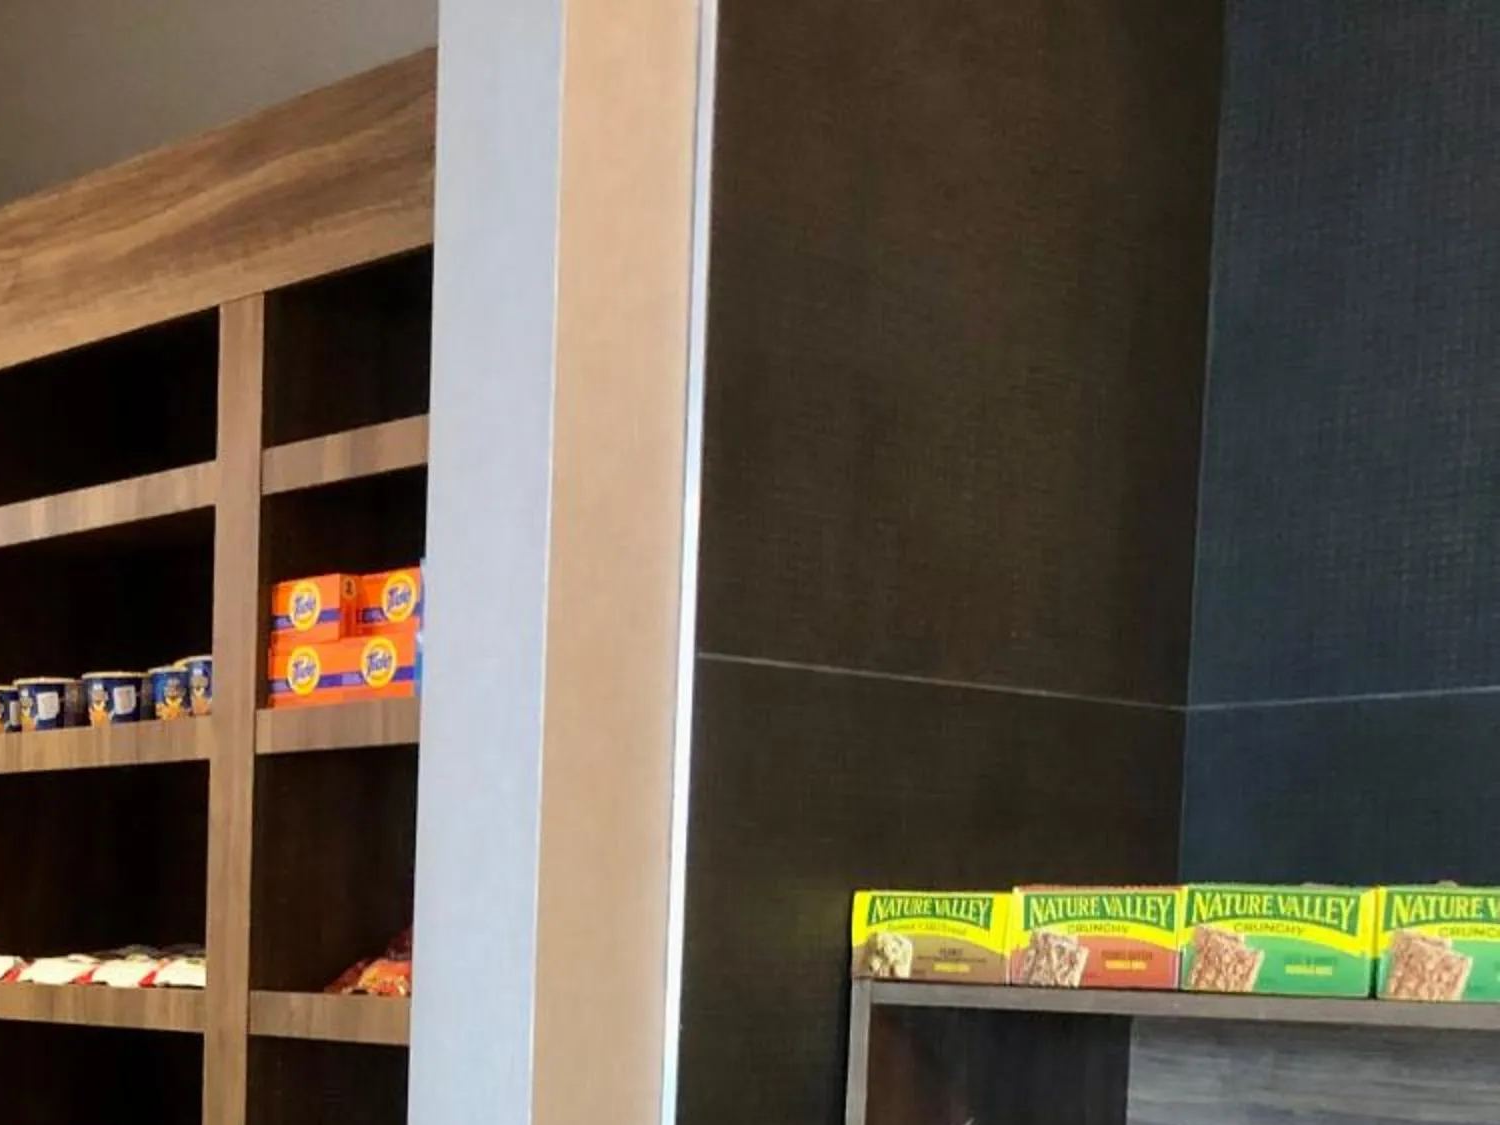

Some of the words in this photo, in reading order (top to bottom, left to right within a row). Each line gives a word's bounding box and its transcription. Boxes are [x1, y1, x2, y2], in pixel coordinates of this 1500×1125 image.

[871, 895, 932, 927] NATURE
[933, 896, 991, 927] VALLEY
[1029, 894, 1099, 927] NATURE
[1101, 895, 1170, 928] VALLEY
[1191, 892, 1273, 922] NATURE
[1277, 894, 1356, 930] VALLEY
[1391, 894, 1484, 927] NATURE
[1438, 926, 1500, 938] CRUNC
